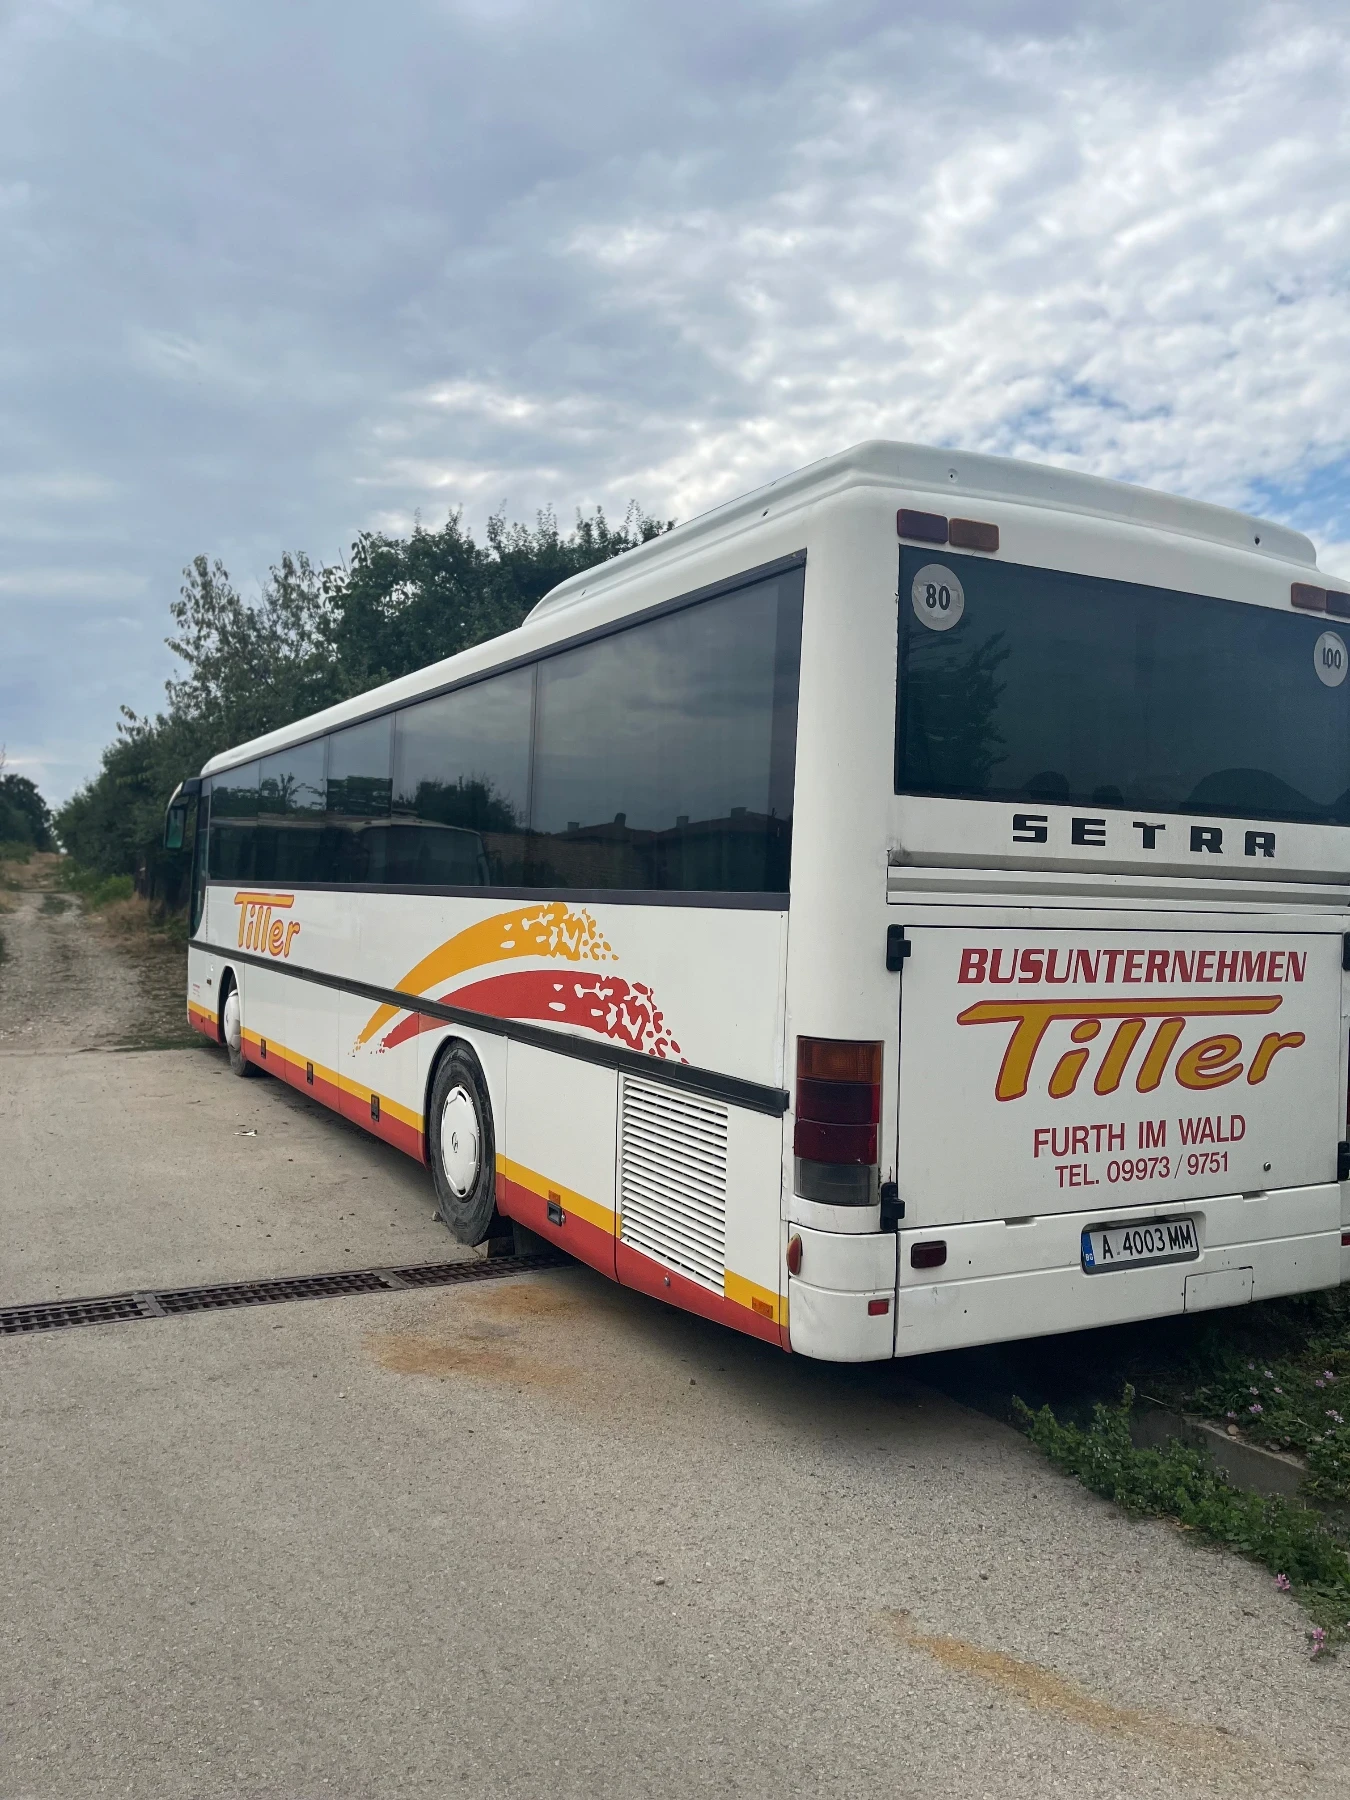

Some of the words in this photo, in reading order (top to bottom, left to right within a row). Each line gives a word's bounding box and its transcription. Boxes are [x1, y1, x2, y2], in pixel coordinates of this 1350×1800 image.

[926, 584, 950, 610] 80
[1323, 647, 1341, 669] 100
[1012, 813, 1276, 858] SETRA
[234, 892, 300, 958] Tiller
[957, 948, 1307, 984] BUSUNTERNEHMEN
[956, 994, 1306, 1102] Tiller
[1033, 1122, 1125, 1158] FURTH
[1138, 1119, 1166, 1150] IM
[1178, 1114, 1246, 1146] WALD
[1055, 1163, 1100, 1188] TEL.
